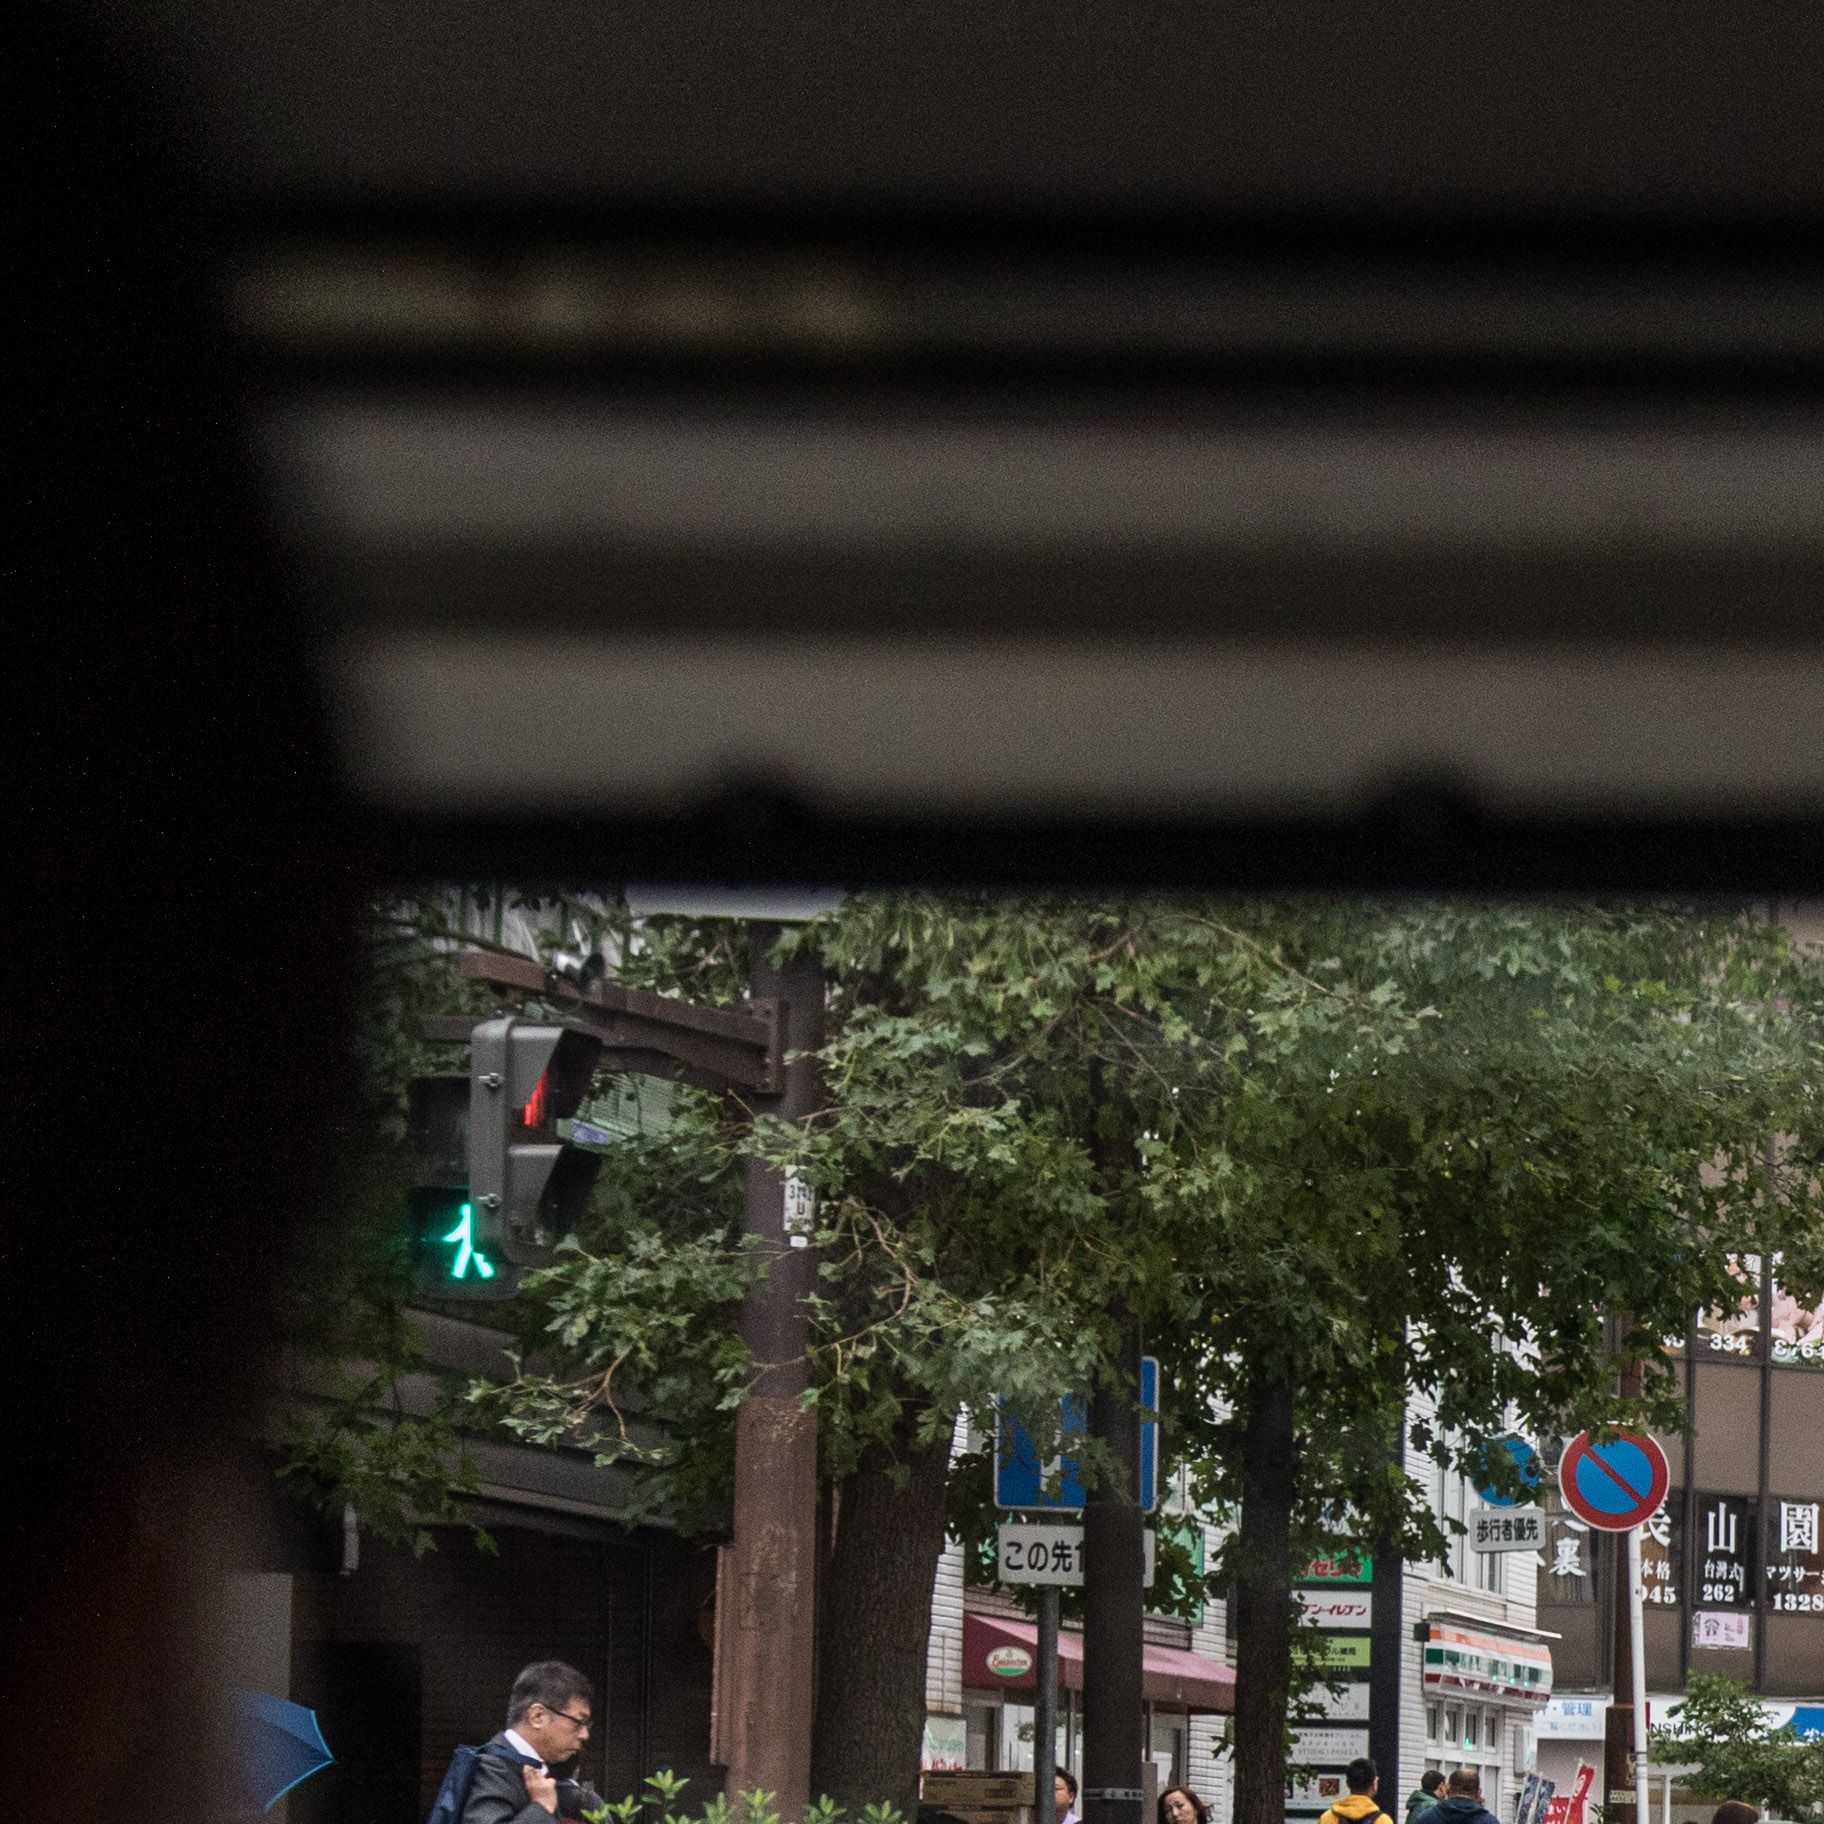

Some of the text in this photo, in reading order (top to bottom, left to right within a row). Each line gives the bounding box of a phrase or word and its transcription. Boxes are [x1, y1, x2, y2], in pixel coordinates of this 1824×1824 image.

[1710, 1333, 1748, 1352] 334
[1476, 1517, 1539, 1542] 歩行者優先
[1702, 1583, 1735, 1602] 262
